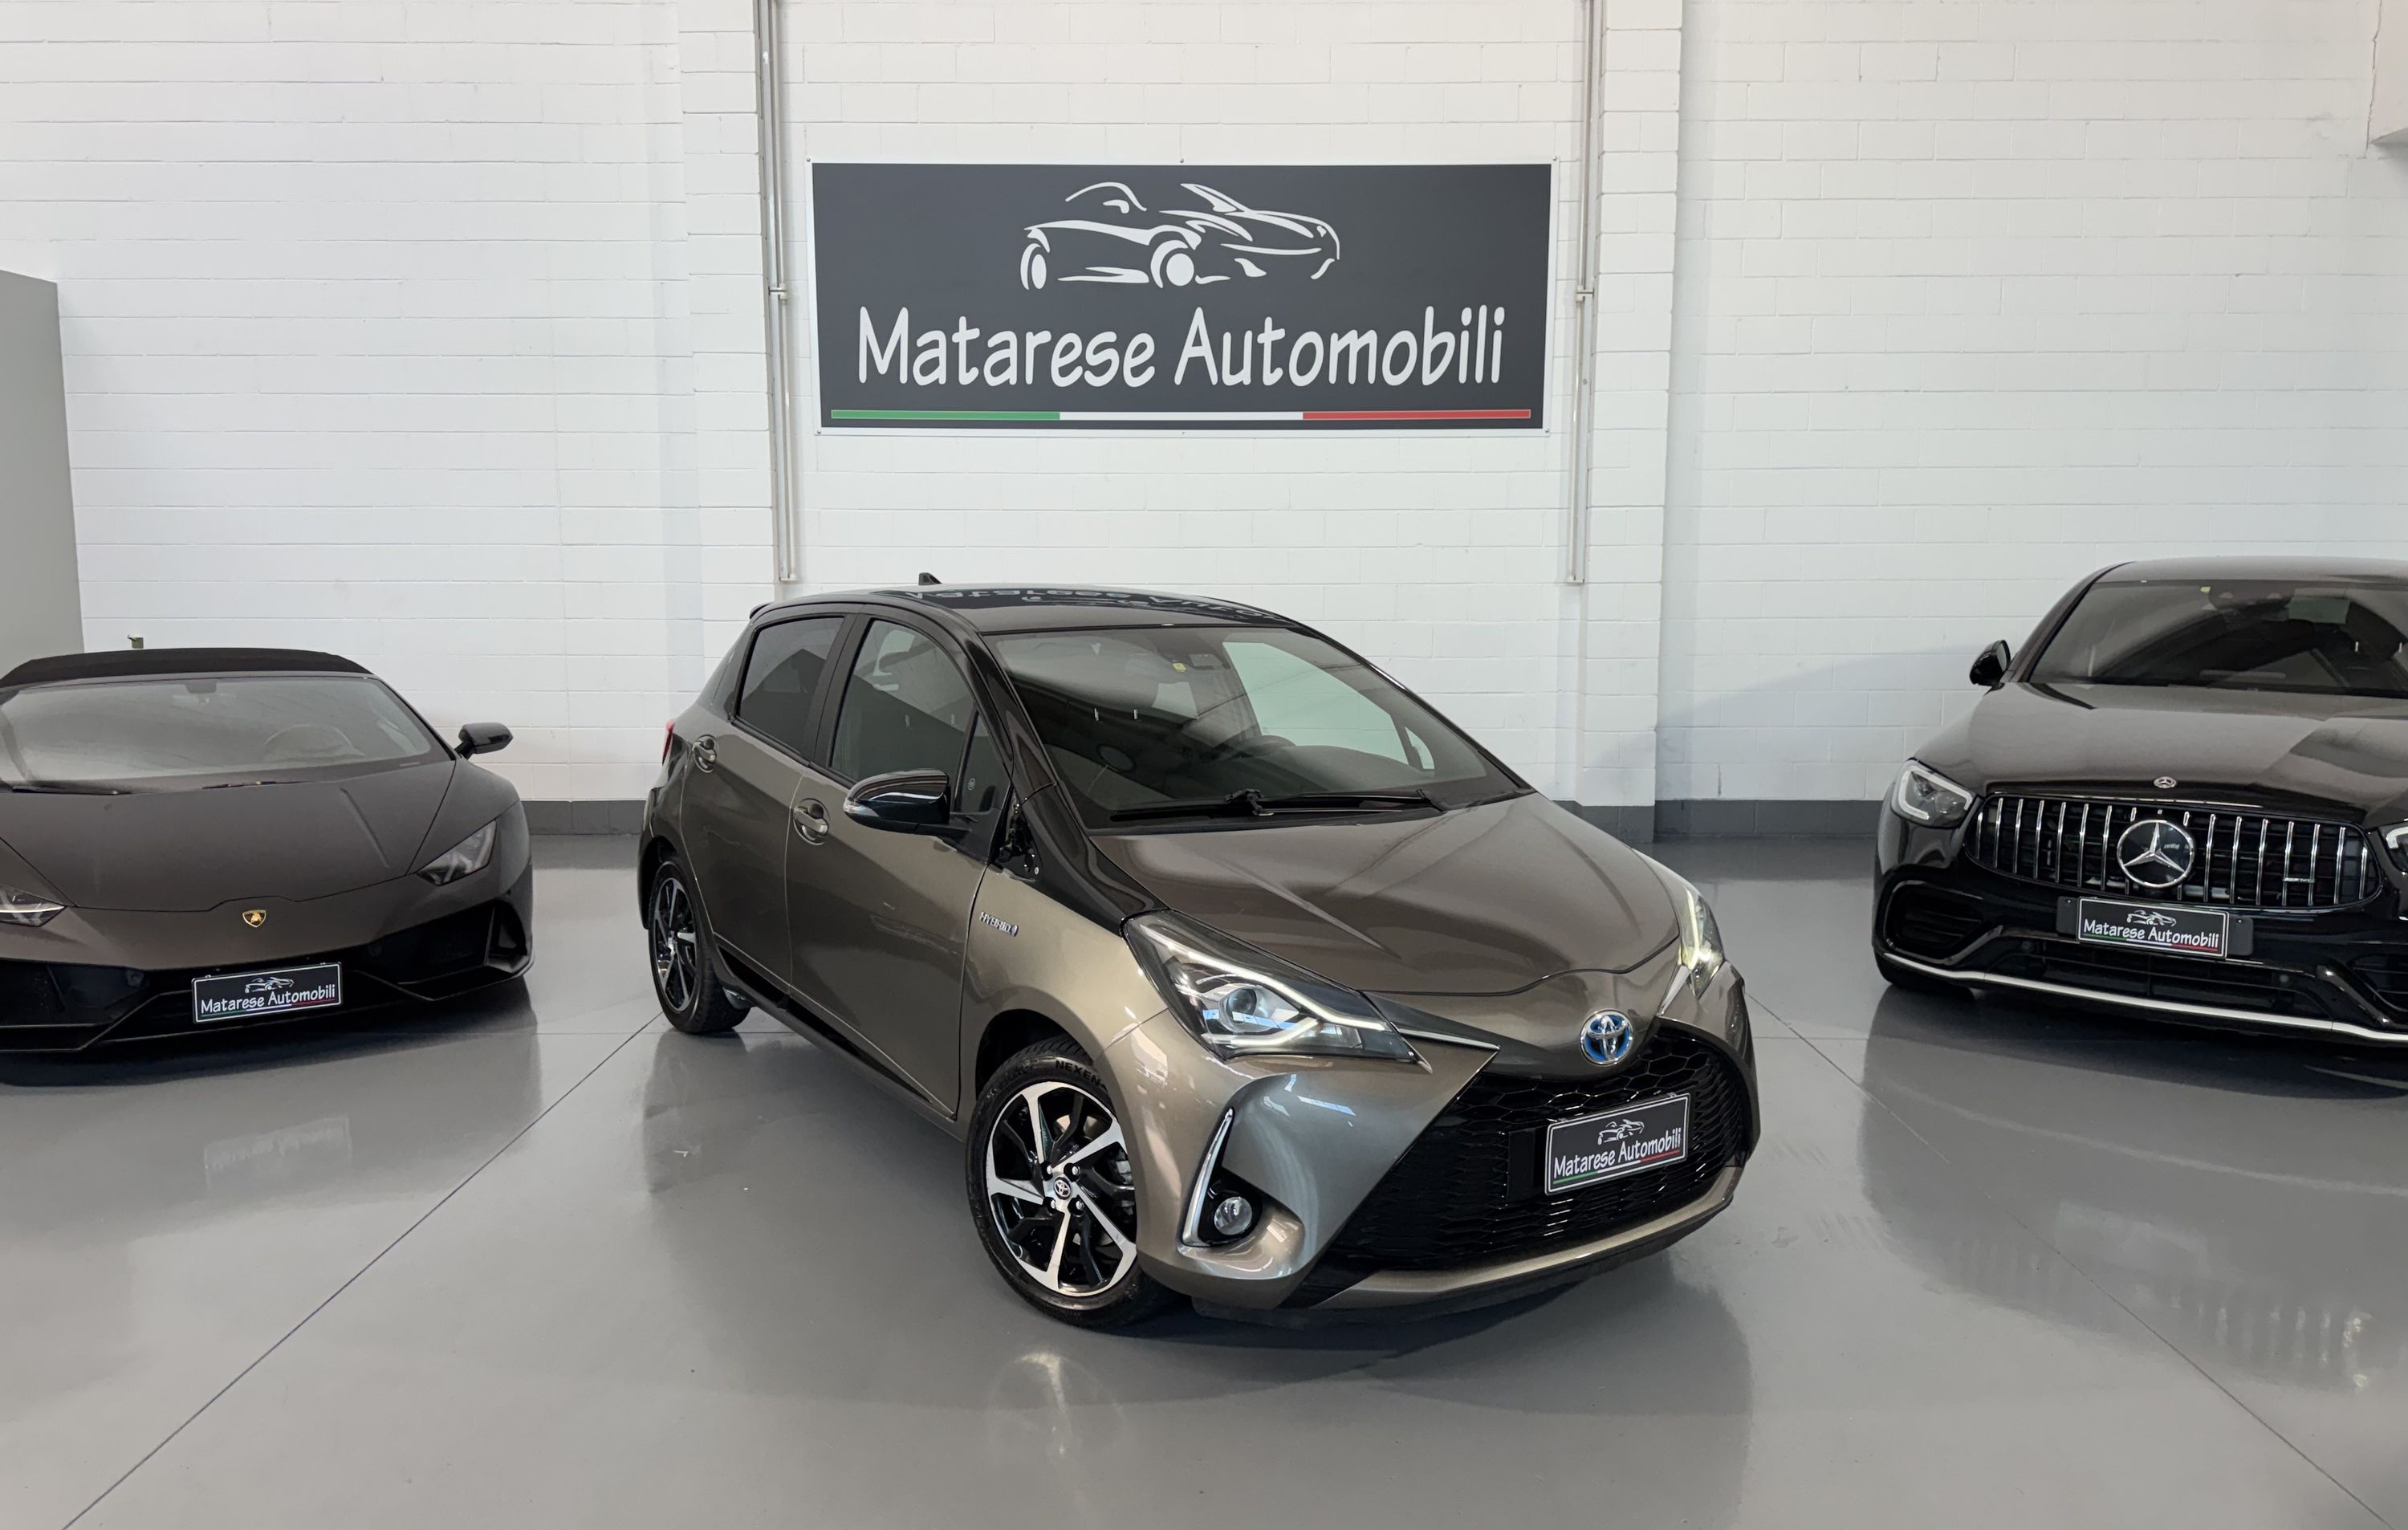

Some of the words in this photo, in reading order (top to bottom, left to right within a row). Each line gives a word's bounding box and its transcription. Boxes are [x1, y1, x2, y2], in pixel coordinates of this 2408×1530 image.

[859, 306, 1156, 388] Matarese
[1173, 305, 1506, 386] Automobili
[2083, 918, 2145, 939] Matarese
[2147, 926, 2219, 948] Automobili
[201, 996, 265, 1014] Matarese
[267, 984, 336, 1006] Automobili
[1056, 1060, 1101, 1084] NEXEN
[1554, 1150, 1616, 1178] Matarese
[1617, 1127, 1682, 1162] Automobili
